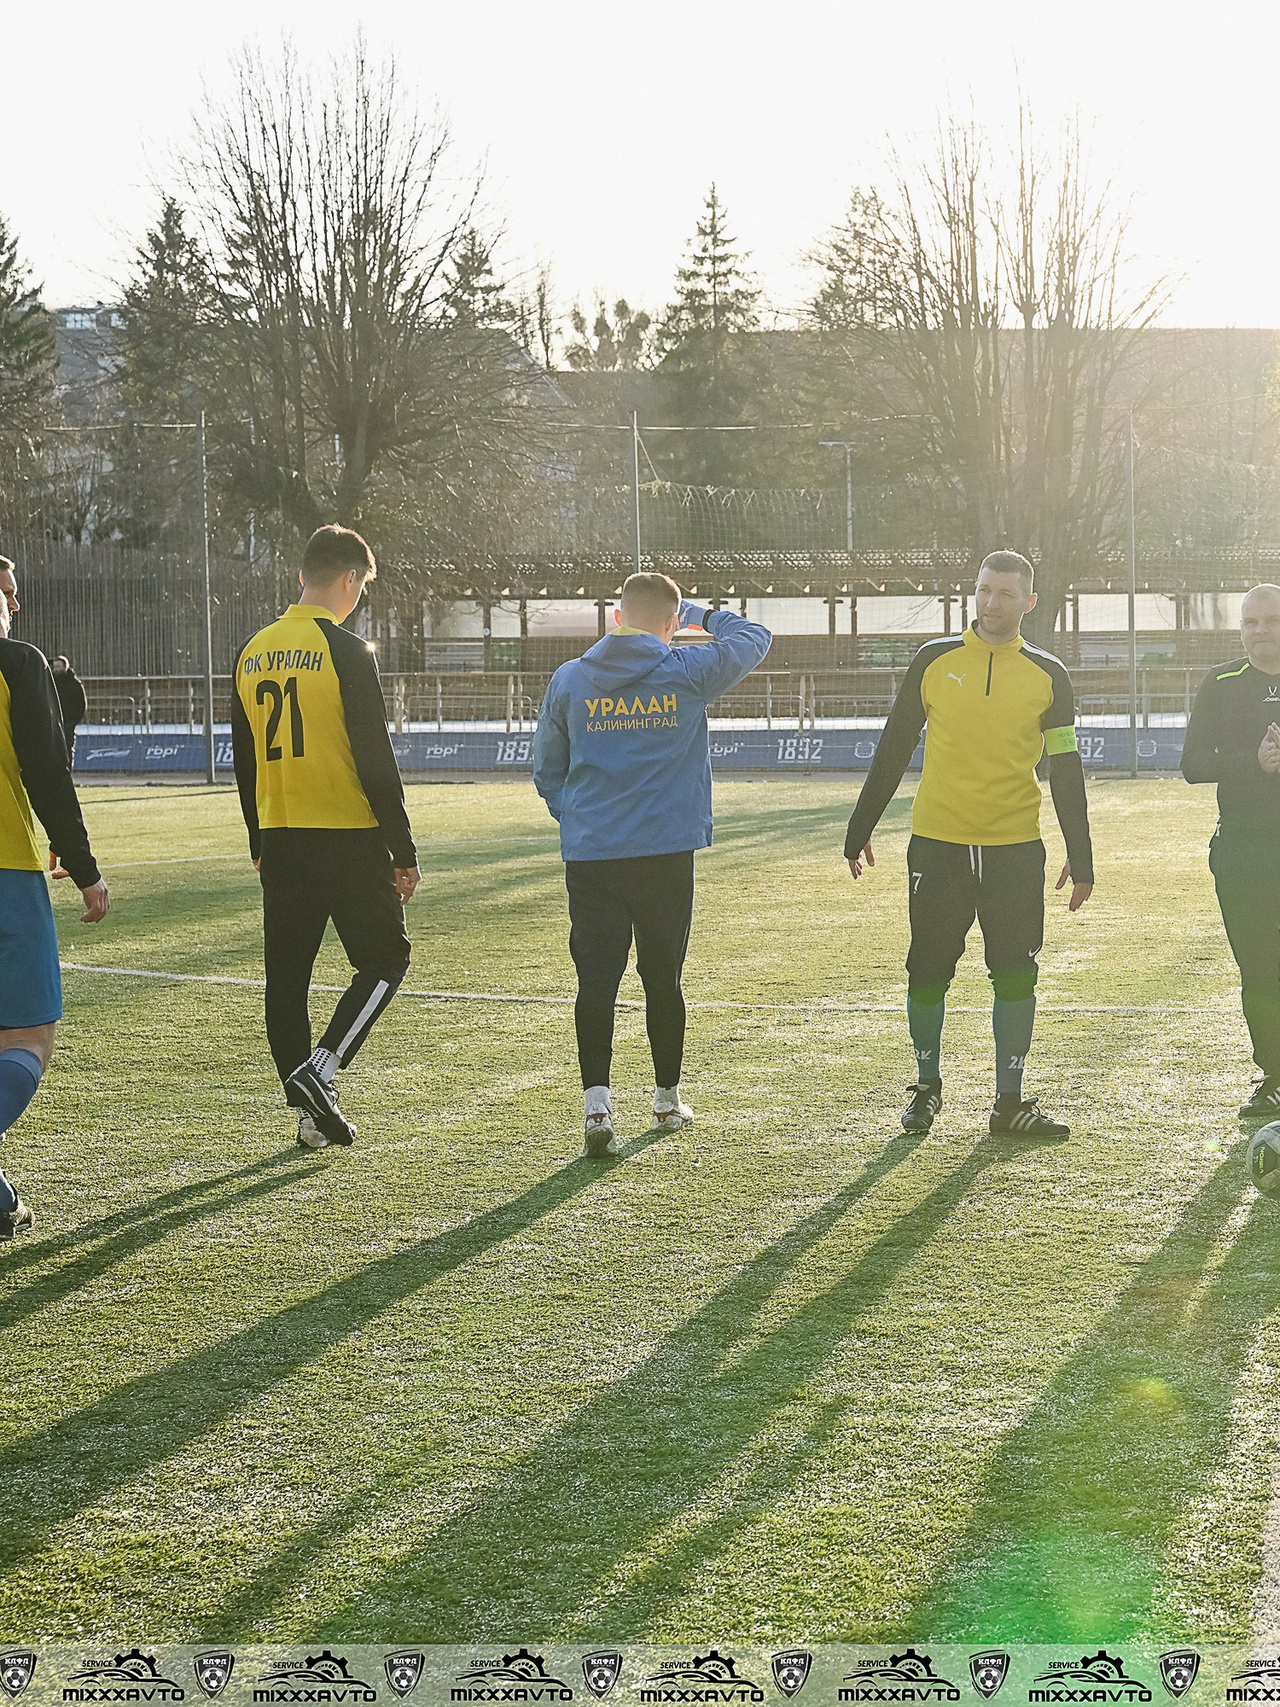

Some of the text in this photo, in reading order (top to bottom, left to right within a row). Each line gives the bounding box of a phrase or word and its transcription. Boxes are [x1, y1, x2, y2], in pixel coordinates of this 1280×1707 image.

[244, 649, 323, 675] ФК УРАЛАН
[584, 693, 678, 717] УРАЛАН
[255, 676, 305, 762] 21
[586, 715, 678, 732] КАЛИНИНГРАД
[777, 739, 823, 760] 1892
